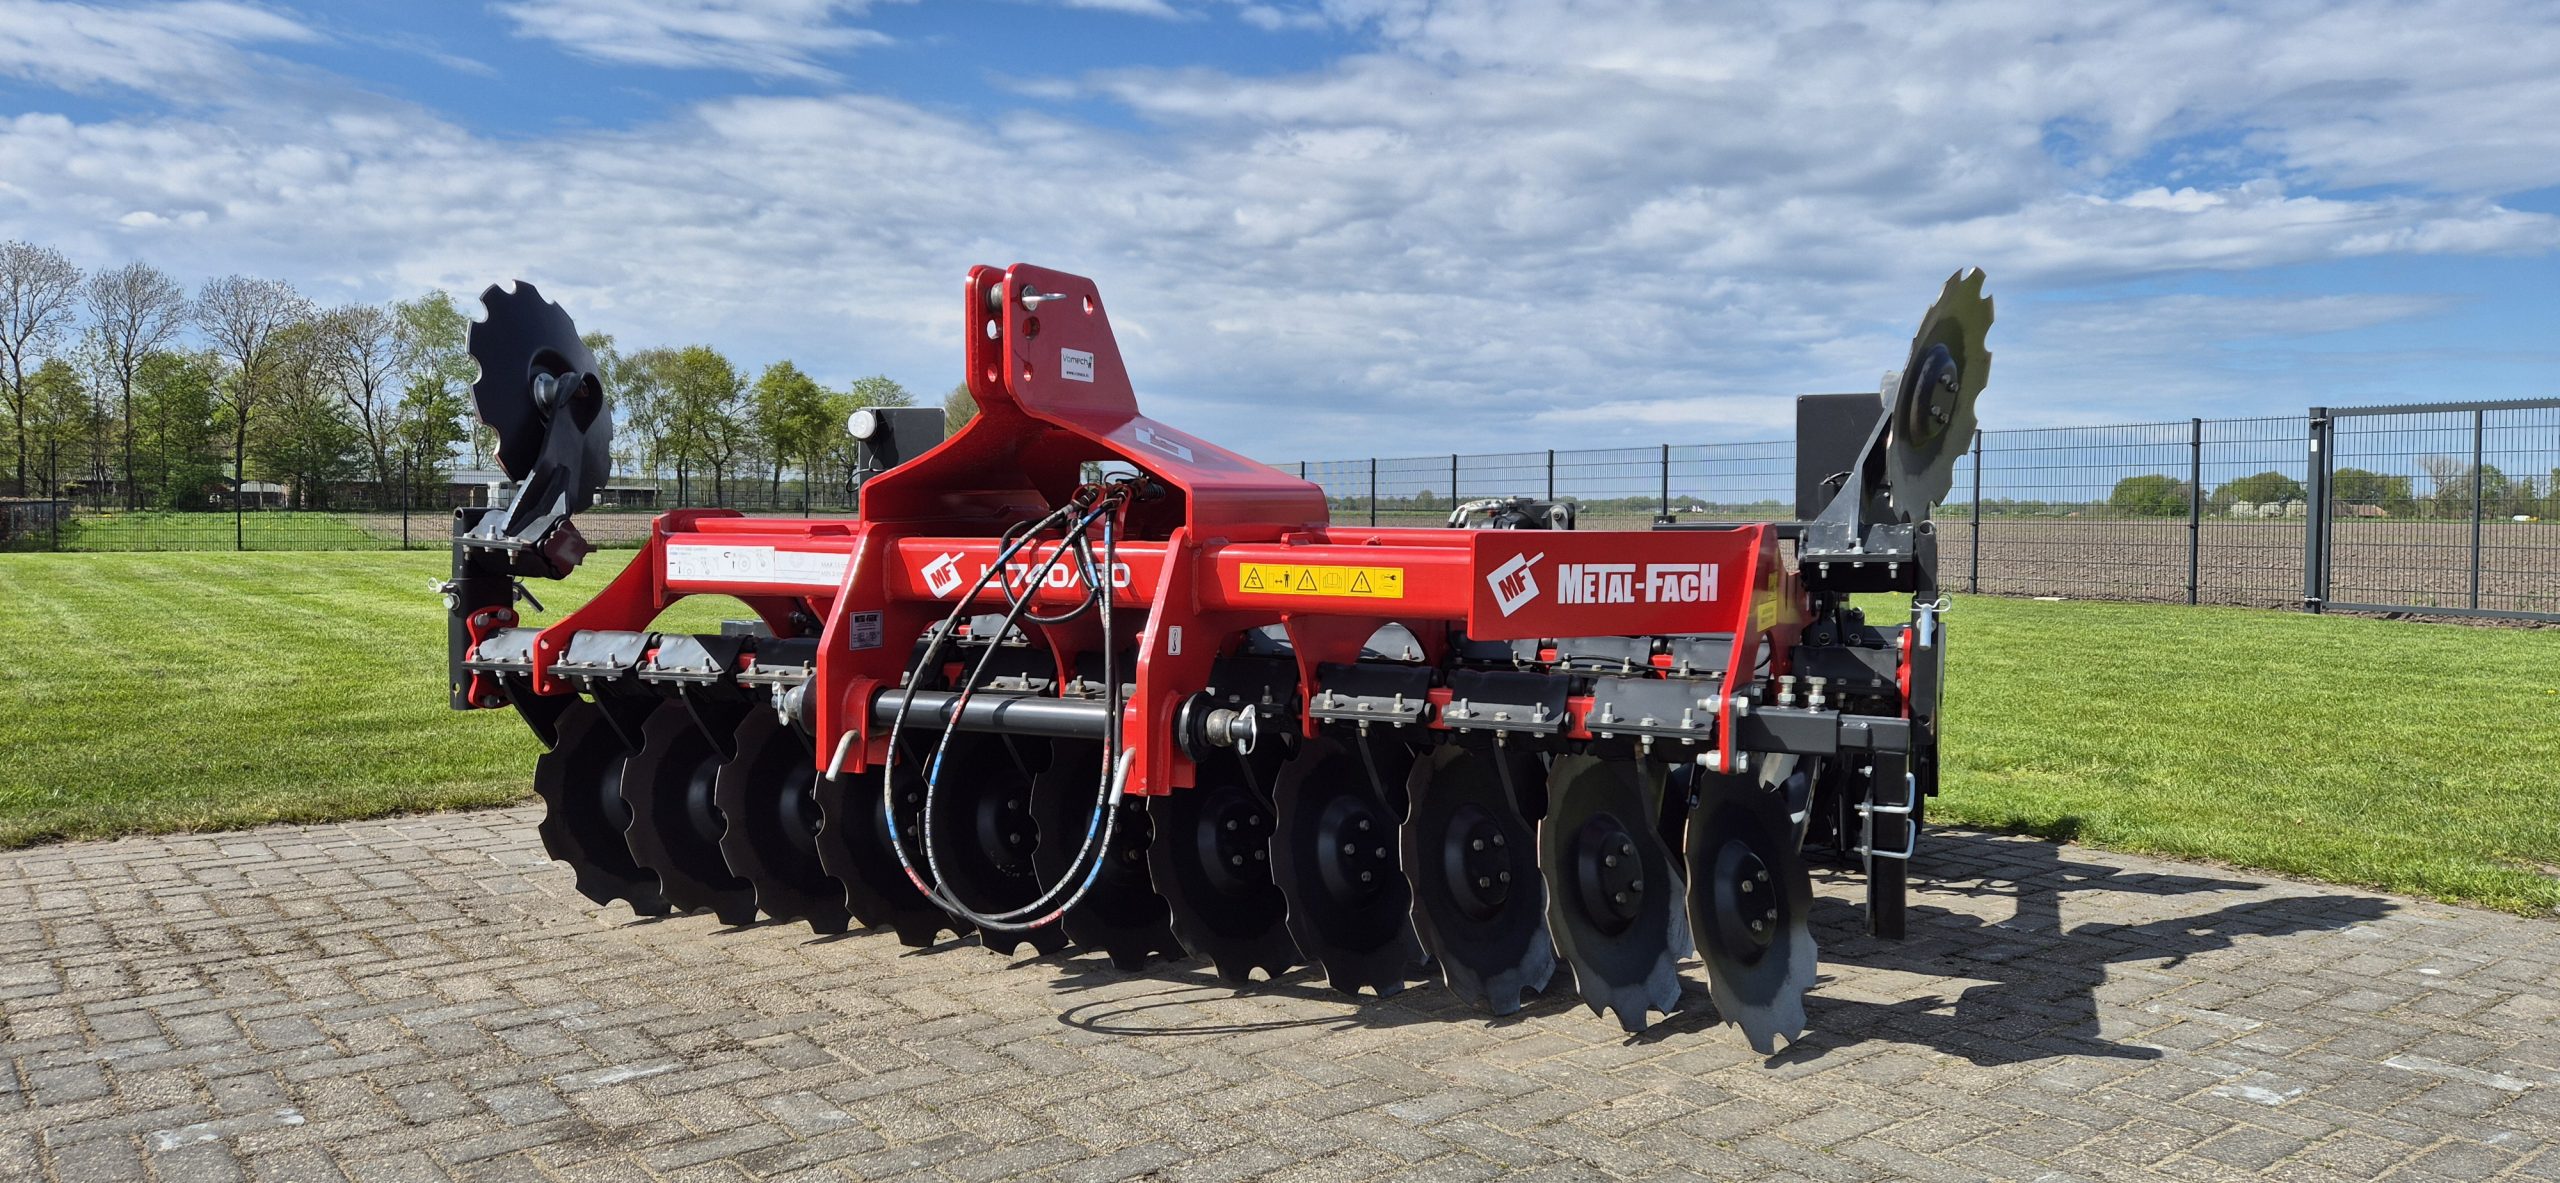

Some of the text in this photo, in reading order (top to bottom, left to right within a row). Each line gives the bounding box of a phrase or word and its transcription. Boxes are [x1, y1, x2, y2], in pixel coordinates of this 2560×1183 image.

[930, 560, 951, 589] MF
[1498, 568, 1528, 602] MF
[1557, 563, 1719, 604] METAL-FACH
